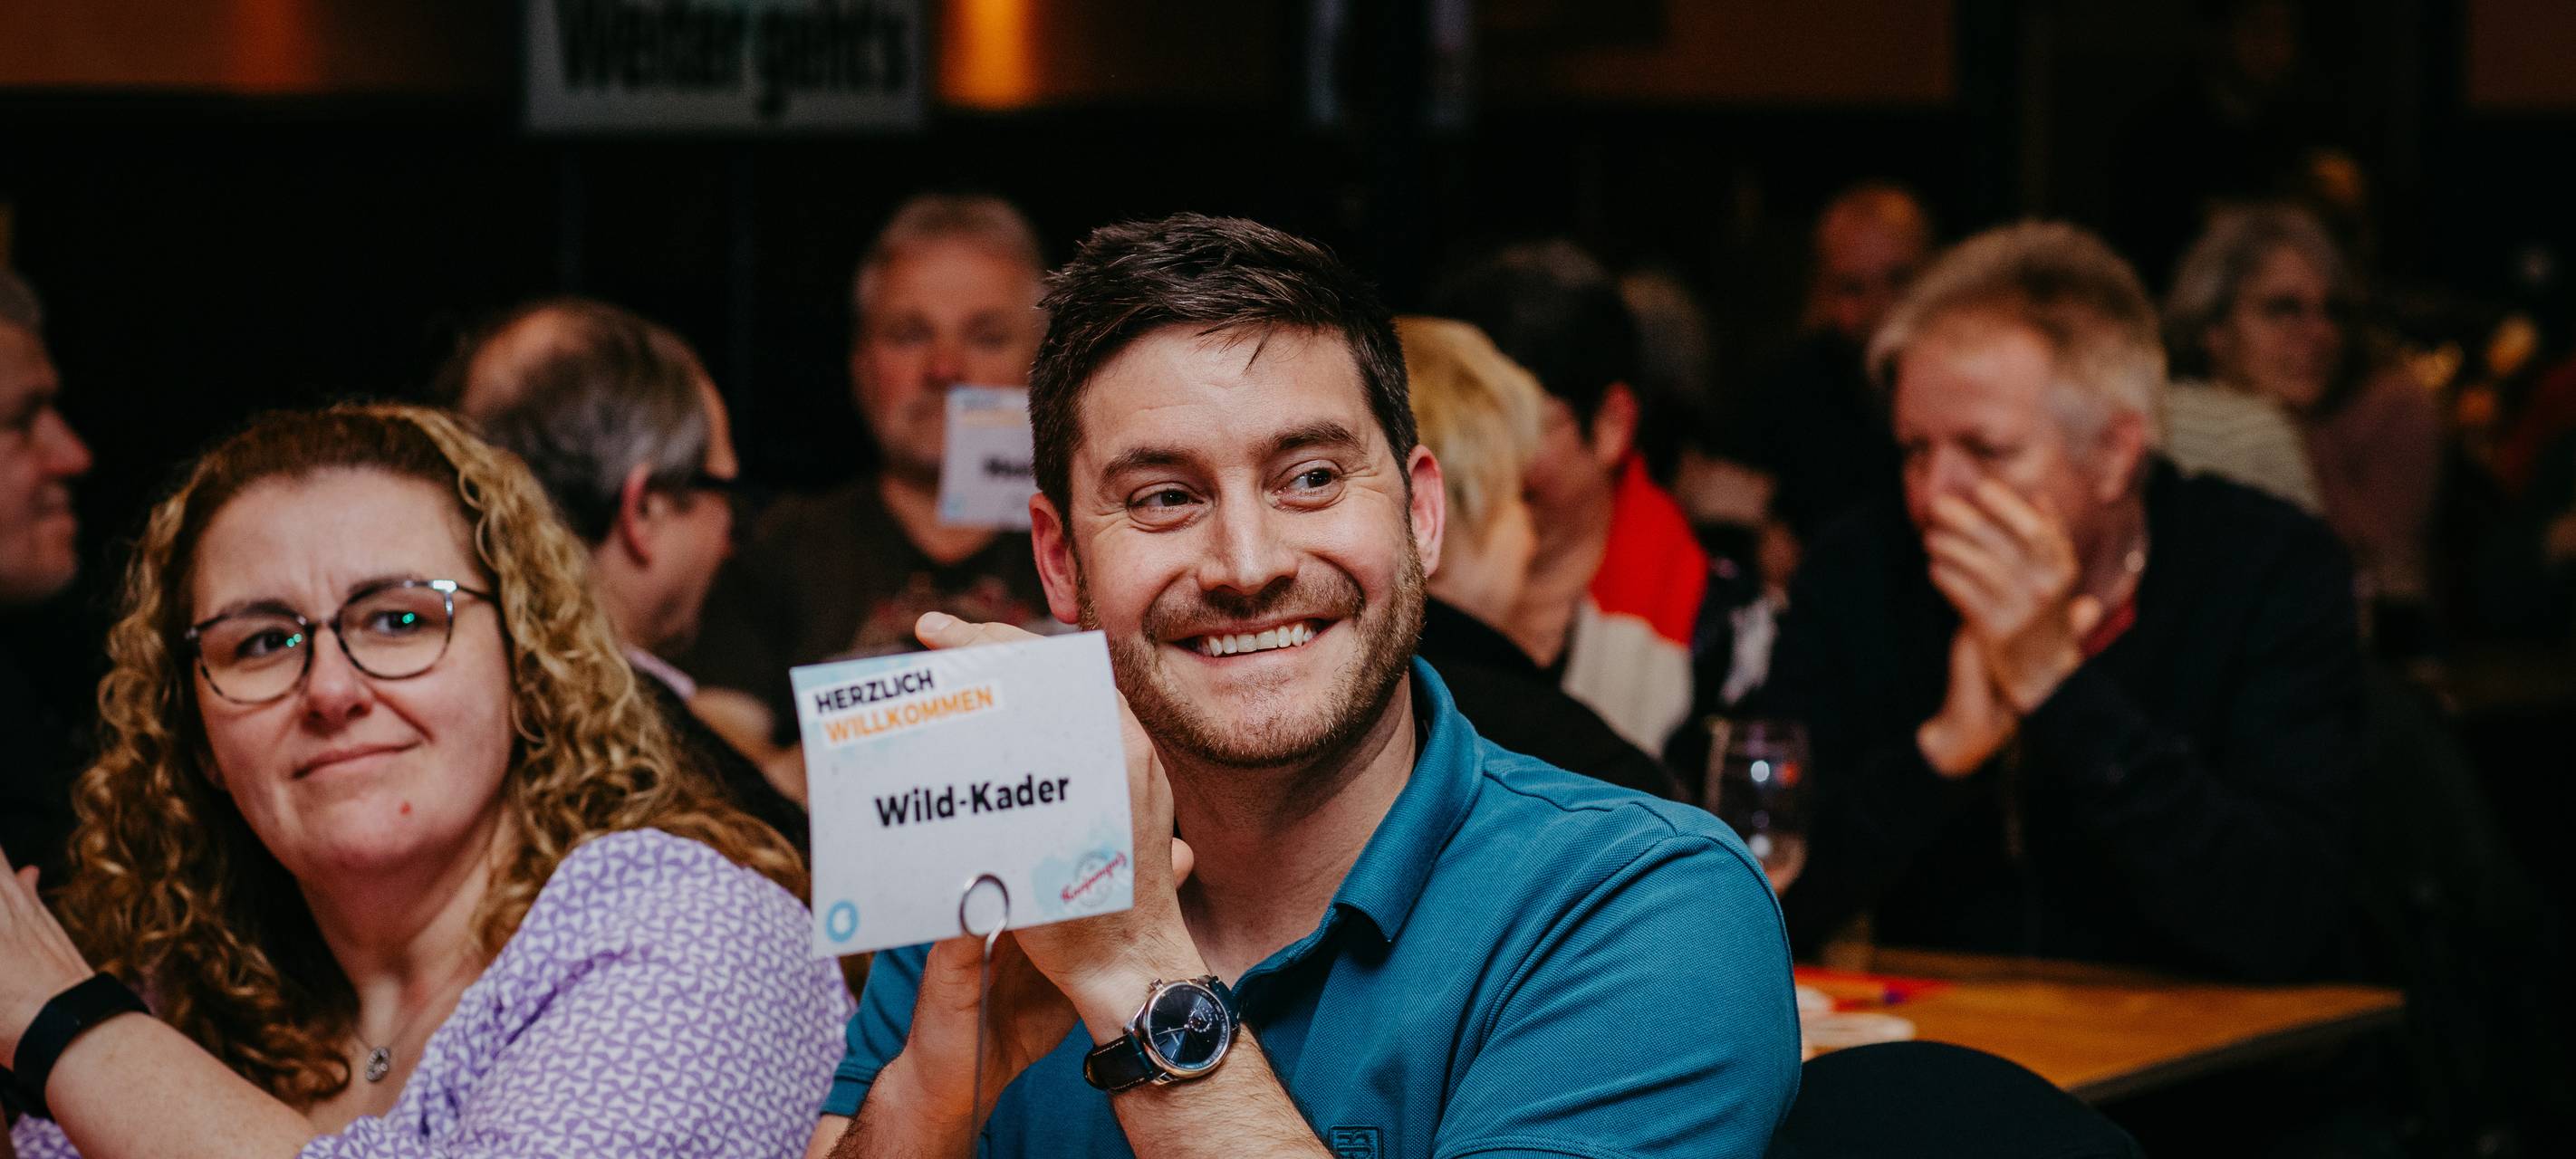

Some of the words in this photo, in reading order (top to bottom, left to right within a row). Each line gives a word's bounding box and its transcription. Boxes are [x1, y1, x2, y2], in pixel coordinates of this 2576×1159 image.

[816, 668, 936, 714] HERZLICH
[825, 685, 995, 744] WILLKOMMEN
[875, 773, 1071, 828] Wild-Kader
